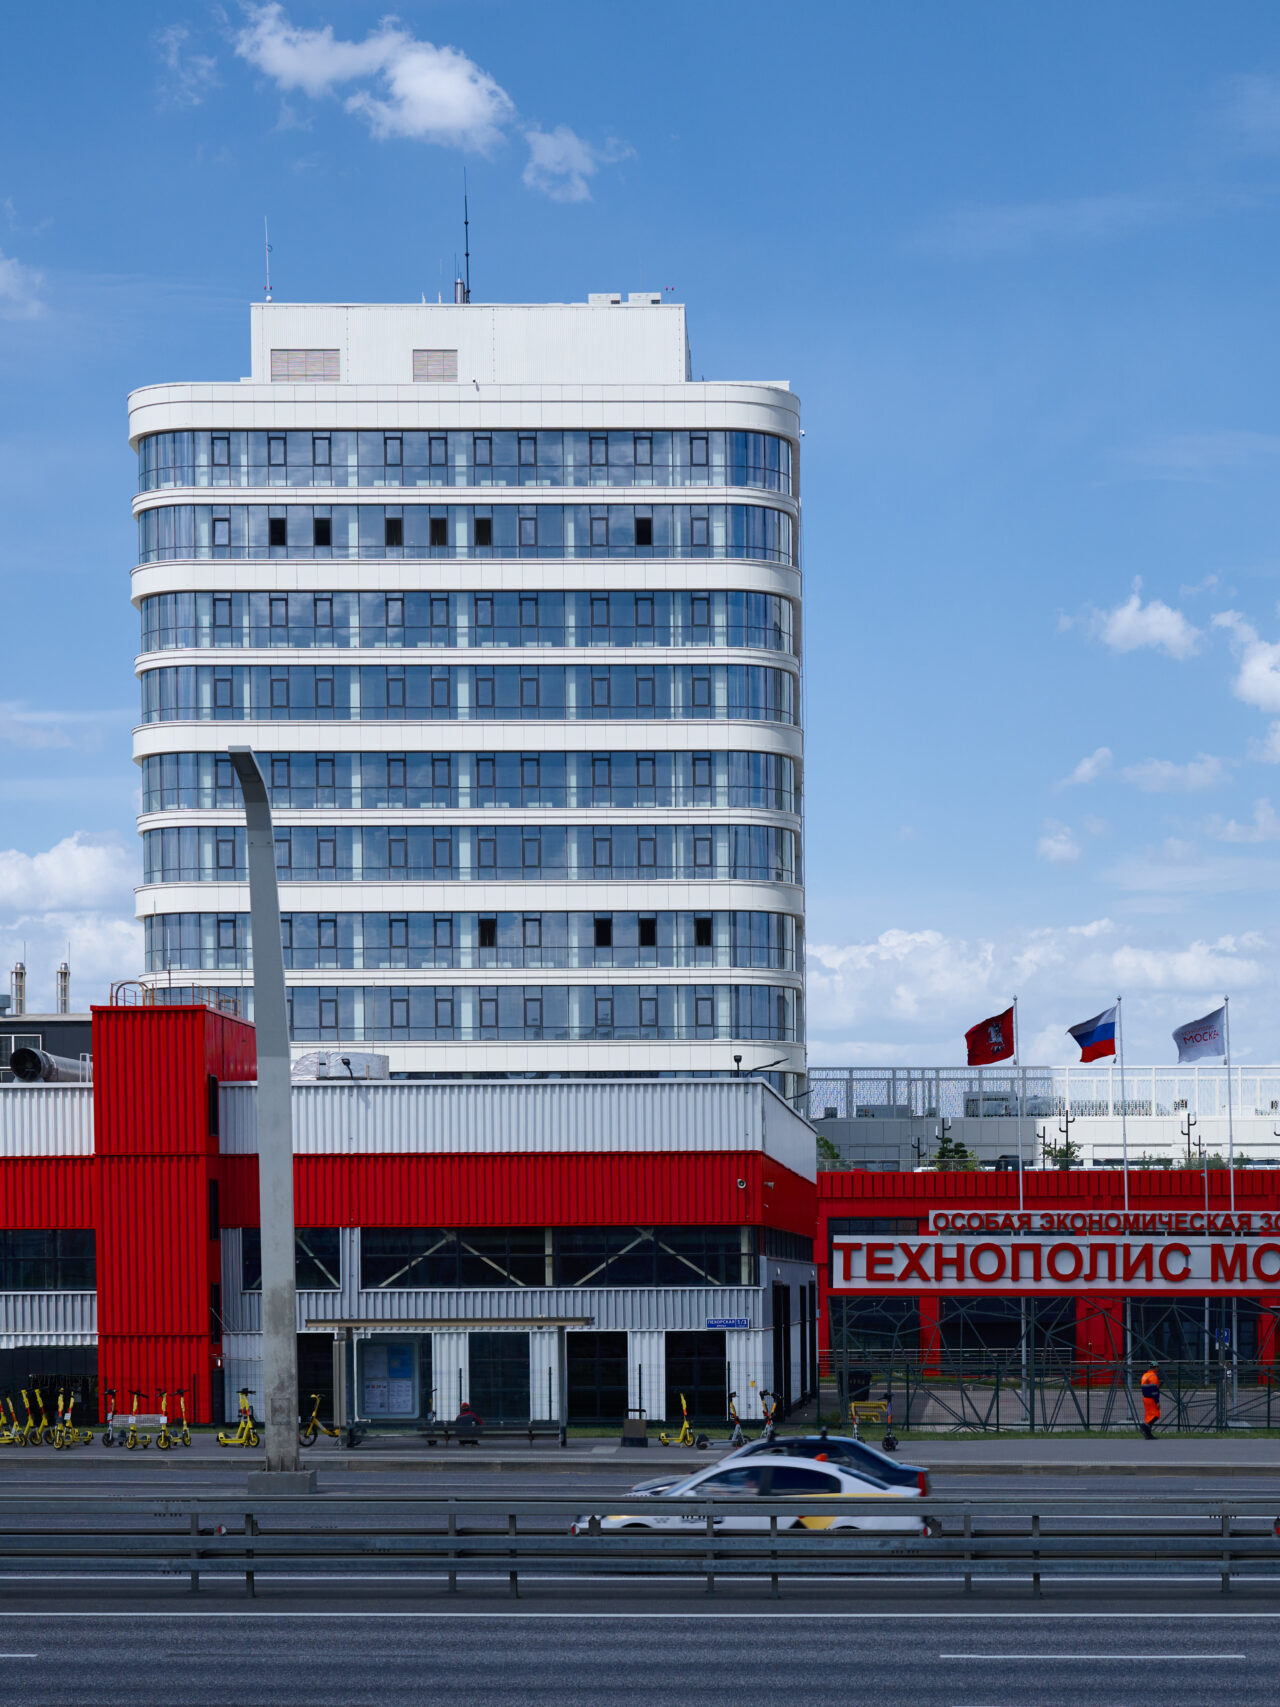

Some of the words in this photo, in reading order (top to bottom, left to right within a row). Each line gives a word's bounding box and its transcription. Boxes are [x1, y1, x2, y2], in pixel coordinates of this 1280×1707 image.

[933, 1212, 1032, 1231] ОСОБАЯ
[1039, 1212, 1251, 1231] ЭКОНОМИЧЕСКАЯ
[832, 1242, 1191, 1282] ТЕХНОПОЛИС
